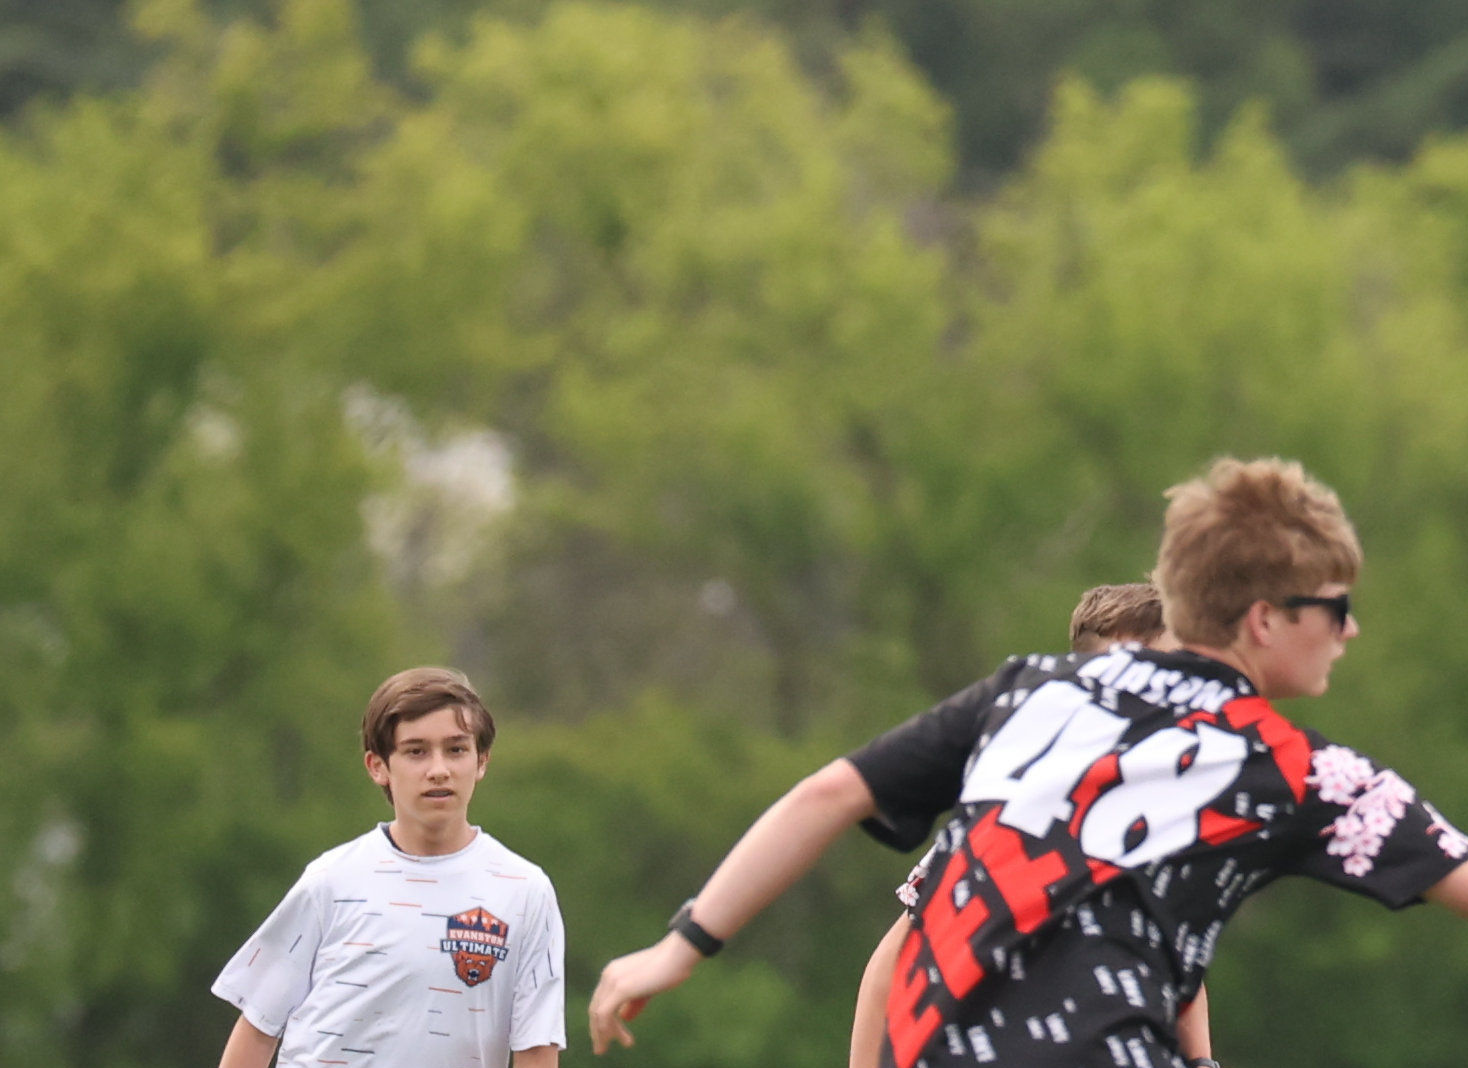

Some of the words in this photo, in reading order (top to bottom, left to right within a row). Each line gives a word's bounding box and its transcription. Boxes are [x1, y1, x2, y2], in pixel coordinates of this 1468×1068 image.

[960, 680, 1249, 869] 48
[449, 929, 505, 946] EVANSTON
[442, 940, 508, 960] ULTIMATE
